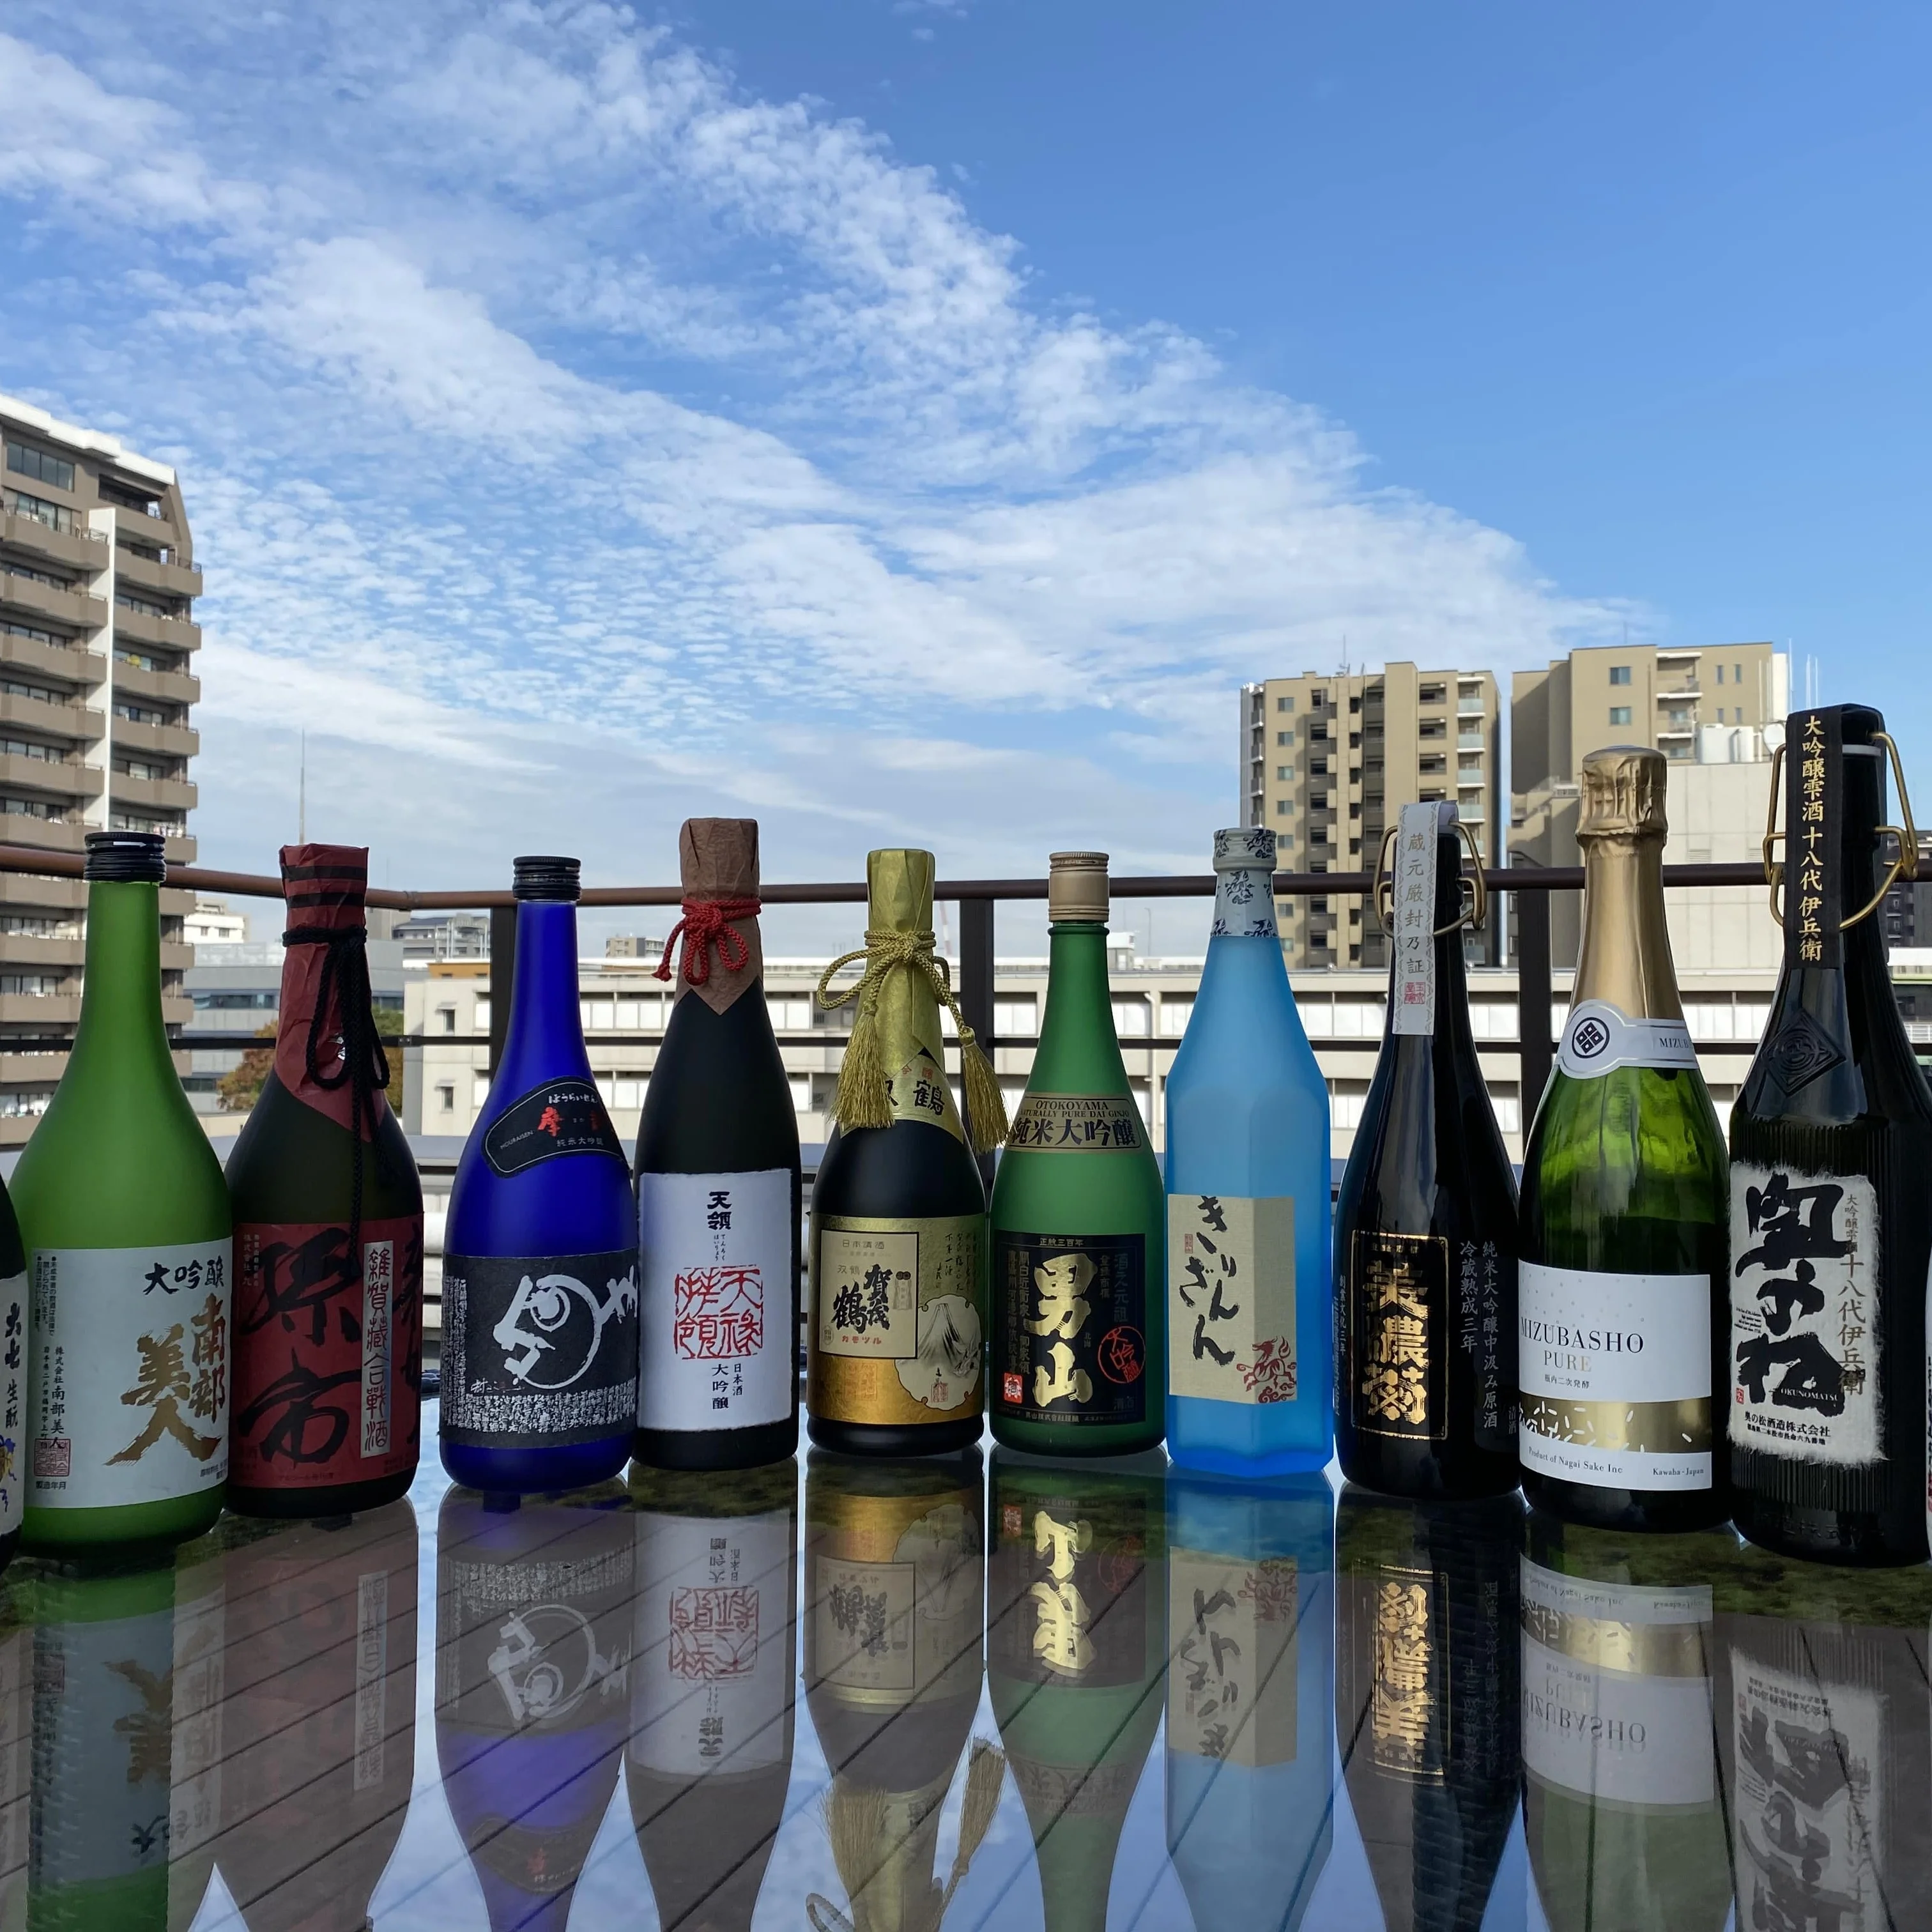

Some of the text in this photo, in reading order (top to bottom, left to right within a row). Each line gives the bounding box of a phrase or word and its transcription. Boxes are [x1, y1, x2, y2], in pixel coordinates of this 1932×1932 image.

[1405, 833, 1425, 974] 蔵元厳封乃証
[1036, 1100, 1109, 1111] OTOKOYAMA
[1061, 1110, 1086, 1119] PURE
[1090, 1110, 1106, 1119] DAI
[1011, 1116, 1137, 1147] 純米大吟醸
[143, 1254, 226, 1296] 大吟醸
[1460, 1241, 1479, 1354] 冷蔵熟成三年
[1026, 1252, 1099, 1407] 男山
[1482, 1240, 1499, 1429] 純米大吟醸中汲み原酒
[1521, 1316, 1644, 1354] MIZUBASHO
[1544, 1349, 1592, 1372] PURE
[711, 1364, 730, 1410] 大吟醸
[733, 1363, 744, 1397] 日本酒
[1744, 1410, 1832, 1438] 奥の松酒造株式会社
[1528, 1445, 1623, 1474] Product of Nagai Sake Inc
